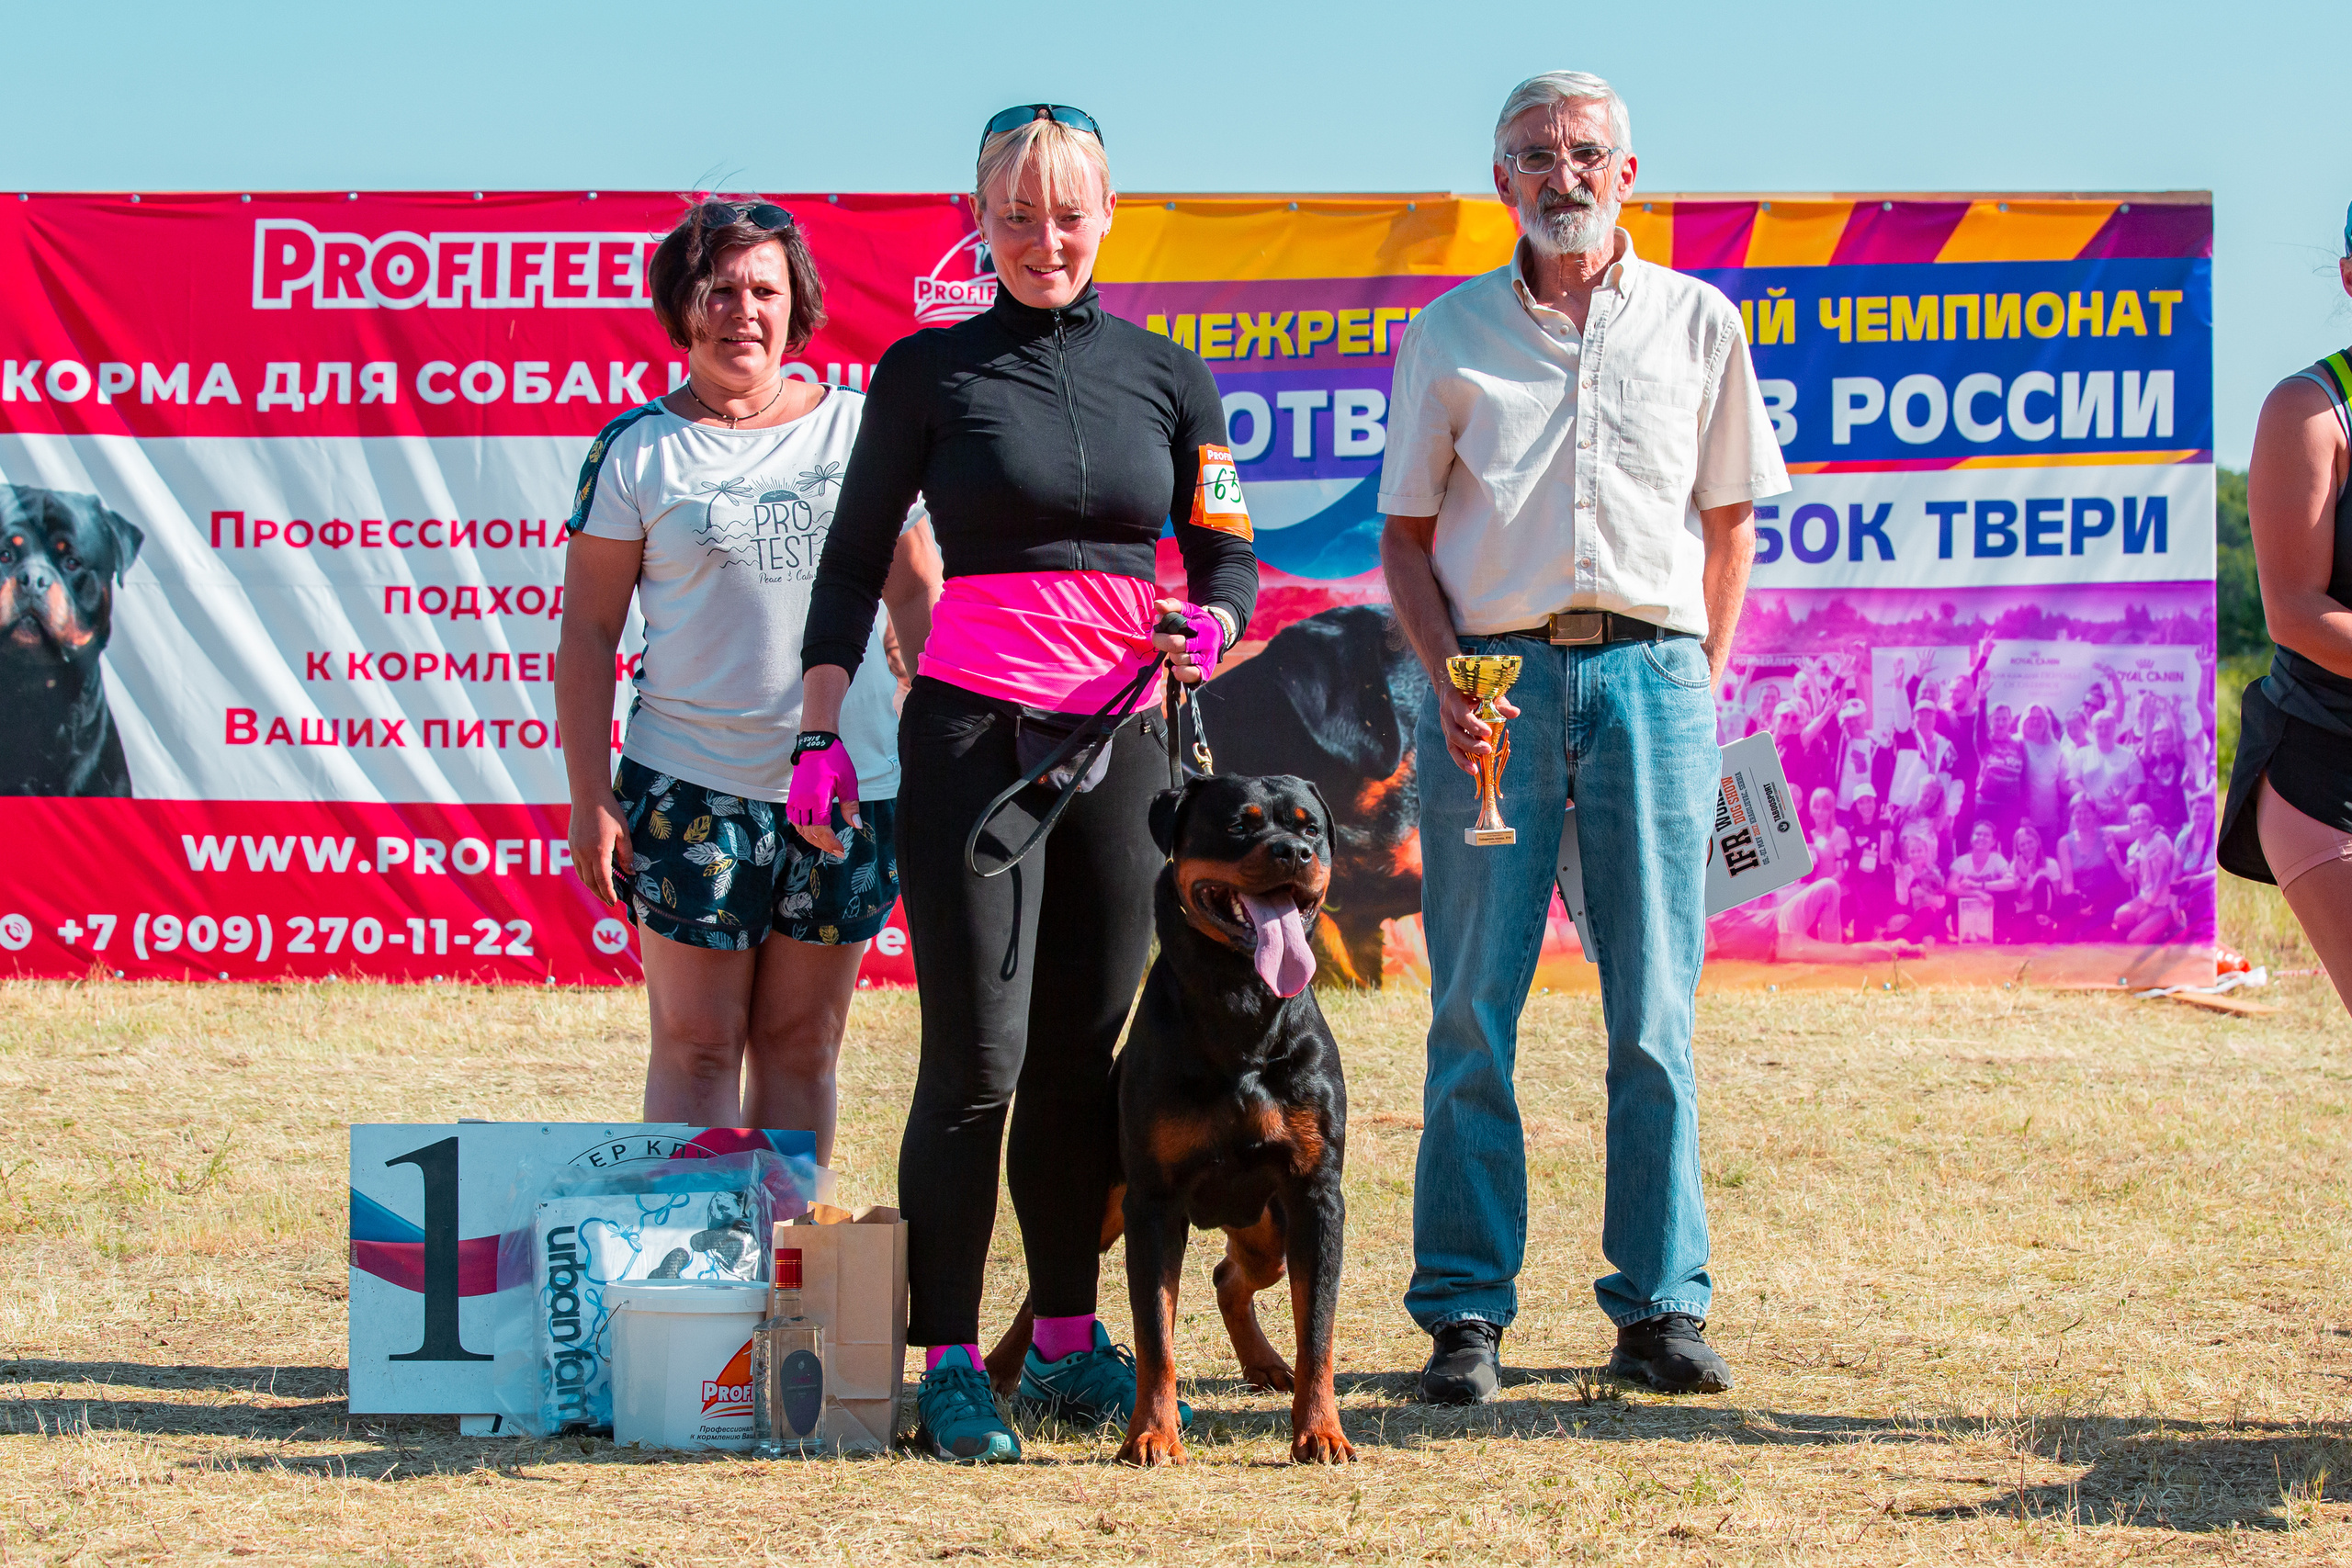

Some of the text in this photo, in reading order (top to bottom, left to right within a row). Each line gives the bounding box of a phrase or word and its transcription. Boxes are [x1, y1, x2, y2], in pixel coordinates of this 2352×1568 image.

[253, 219, 654, 310] PROFIFEE
[1147, 308, 1421, 359] МЕЖРЕГ
[1818, 289, 2183, 344] ЧЕМПИОНАТ
[2, 358, 243, 405] КОРМА
[257, 361, 397, 412] ДЛЯ
[416, 360, 649, 404] СОБАК
[1832, 369, 2175, 446] РОССИИ
[753, 500, 812, 536] PRO
[1926, 496, 2168, 560] ТВЕРИ
[750, 533, 818, 570] TEST
[759, 571, 782, 584] Peace
[306, 651, 332, 681] К
[225, 707, 407, 749] ВАШИХ
[1721, 776, 1746, 824] DOG SHOW
[1763, 783, 1781, 822] TABOOSPORT
[1719, 827, 1761, 878] IFR
[1756, 836, 1764, 848] MAY
[58, 912, 534, 962] +7 (909) 270-11-22
[385, 1136, 494, 1361] 1
[547, 1225, 586, 1343] urban
